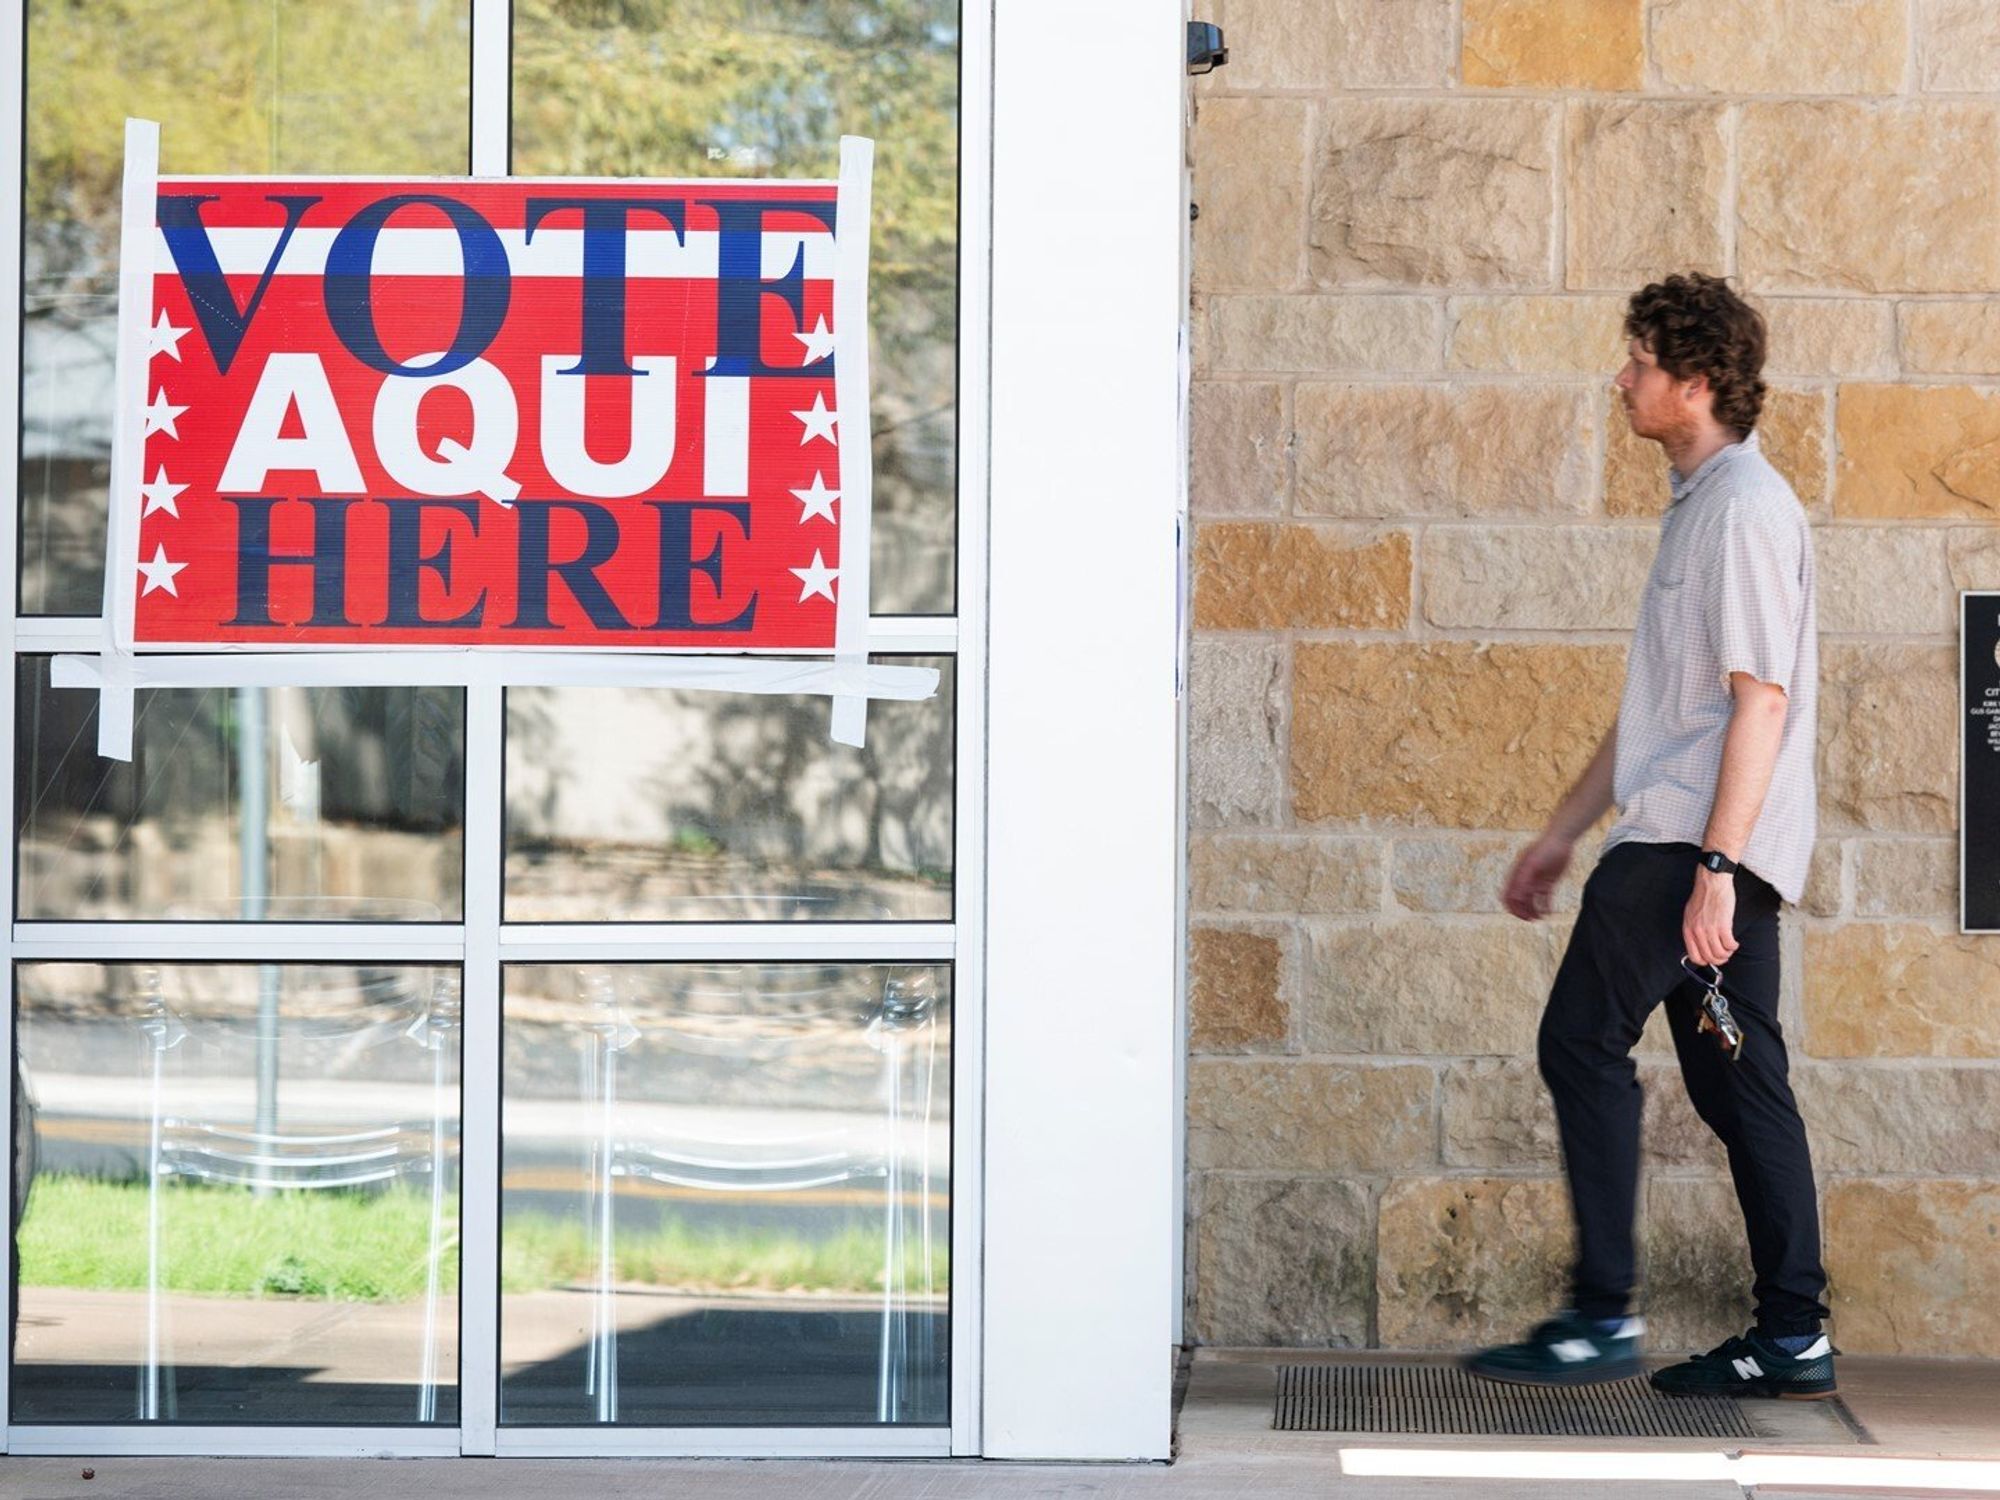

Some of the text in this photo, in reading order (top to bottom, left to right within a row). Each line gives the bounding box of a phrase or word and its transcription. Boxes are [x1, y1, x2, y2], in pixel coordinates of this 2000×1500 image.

[155, 194, 837, 378] VOTE
[216, 351, 751, 510] AQUI
[218, 497, 759, 632] HERE
[1731, 1356, 1765, 1380] N
